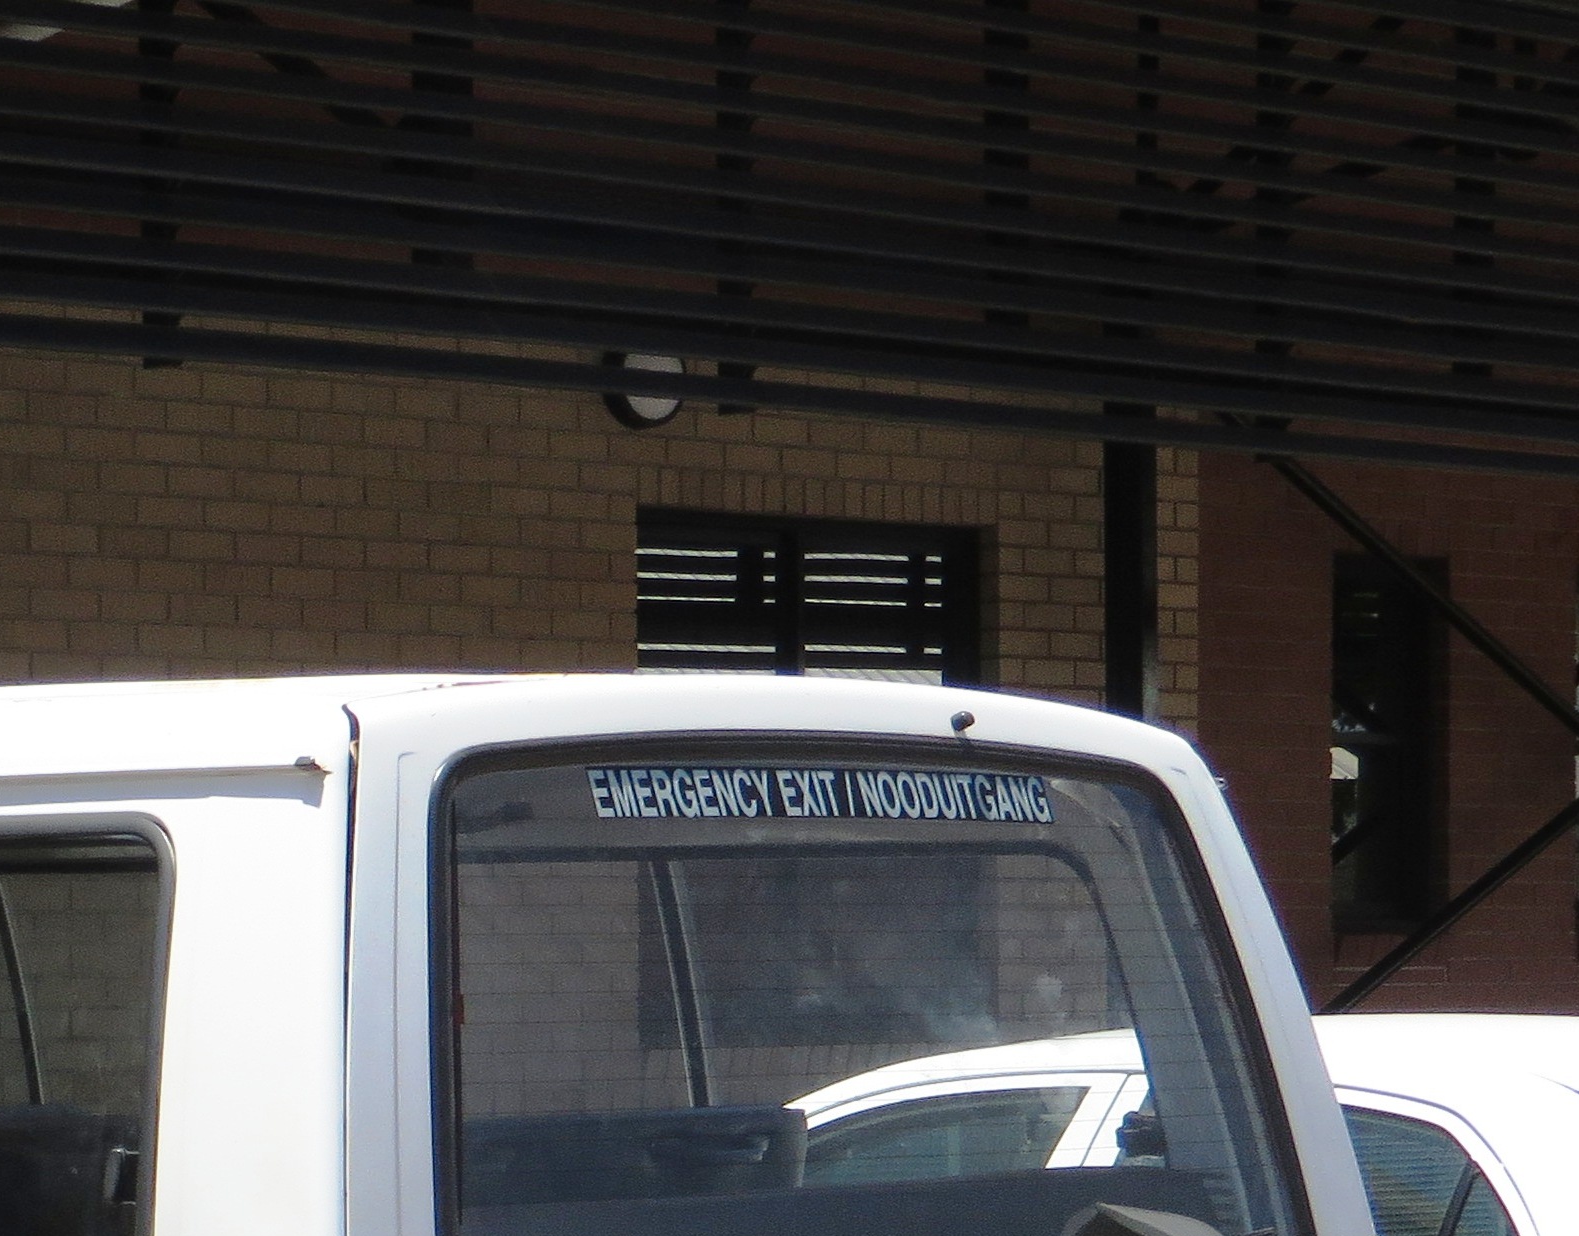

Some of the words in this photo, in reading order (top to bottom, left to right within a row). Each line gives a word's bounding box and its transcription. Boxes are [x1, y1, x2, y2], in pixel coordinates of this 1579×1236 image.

[587, 768, 773, 818] EMERGENCY
[776, 770, 839, 817] EXIT
[844, 771, 855, 817] /
[856, 772, 1051, 822] NOODUITGANG
